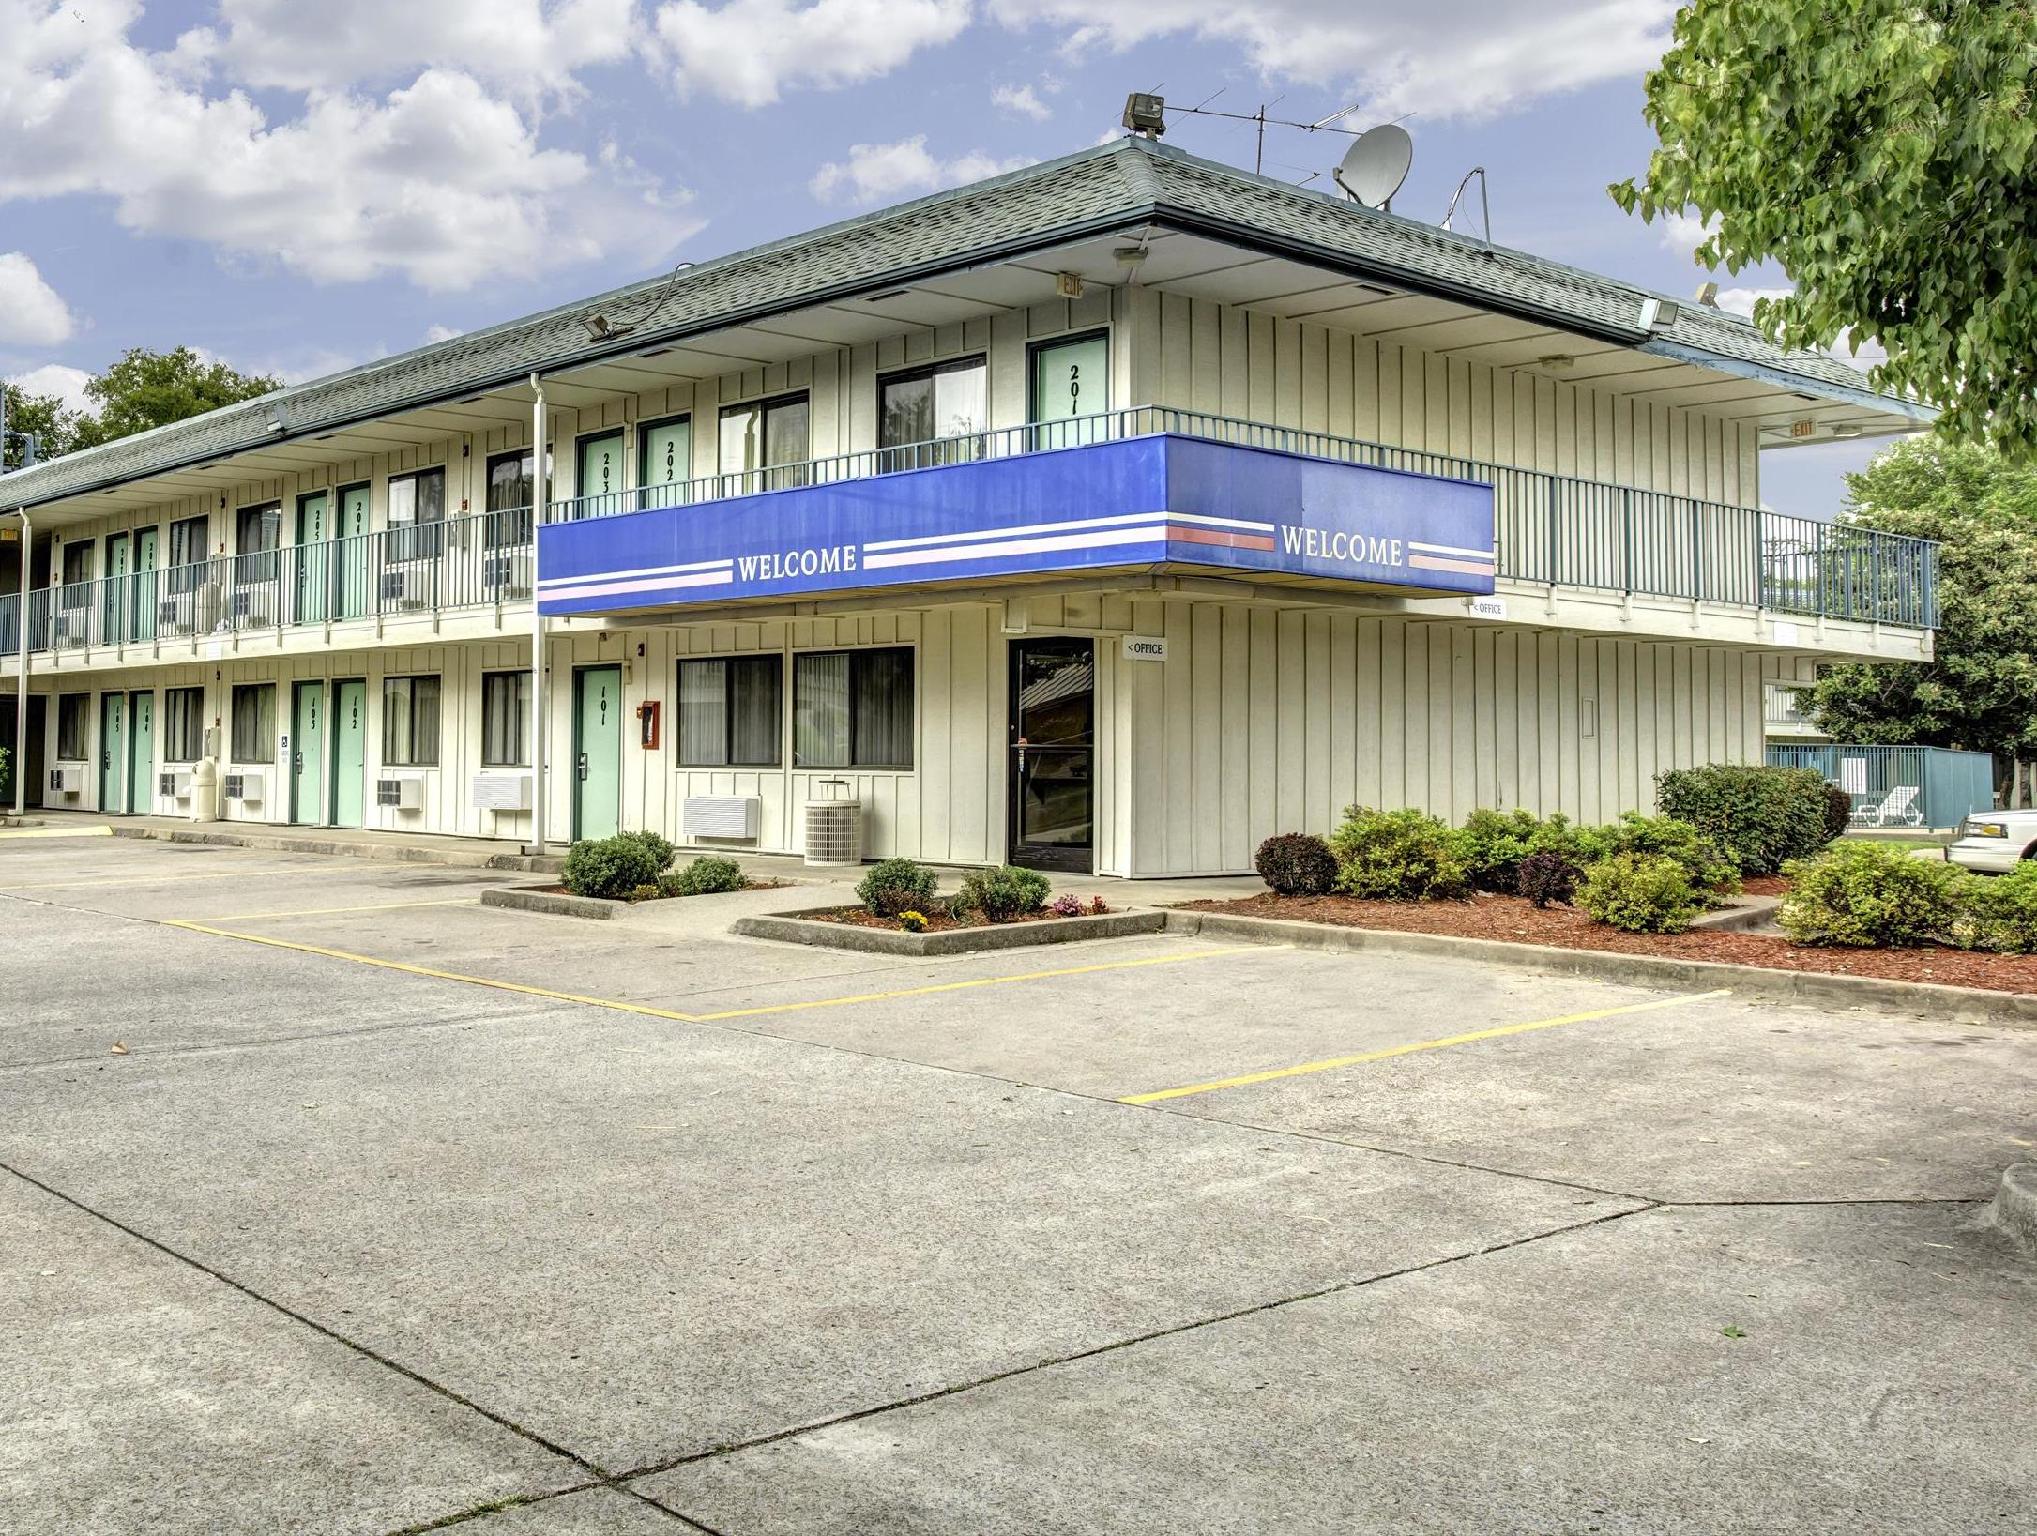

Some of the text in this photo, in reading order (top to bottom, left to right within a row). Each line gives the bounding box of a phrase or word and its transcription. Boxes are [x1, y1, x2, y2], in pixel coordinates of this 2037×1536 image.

[1070, 364, 1080, 416] 201
[602, 452, 610, 494] 203
[666, 441, 675, 482] 202
[738, 545, 857, 582] WELCOME
[1281, 524, 1403, 567] WELCOME
[1480, 602, 1502, 615] OFFICE
[1133, 642, 1164, 655] OFFICE
